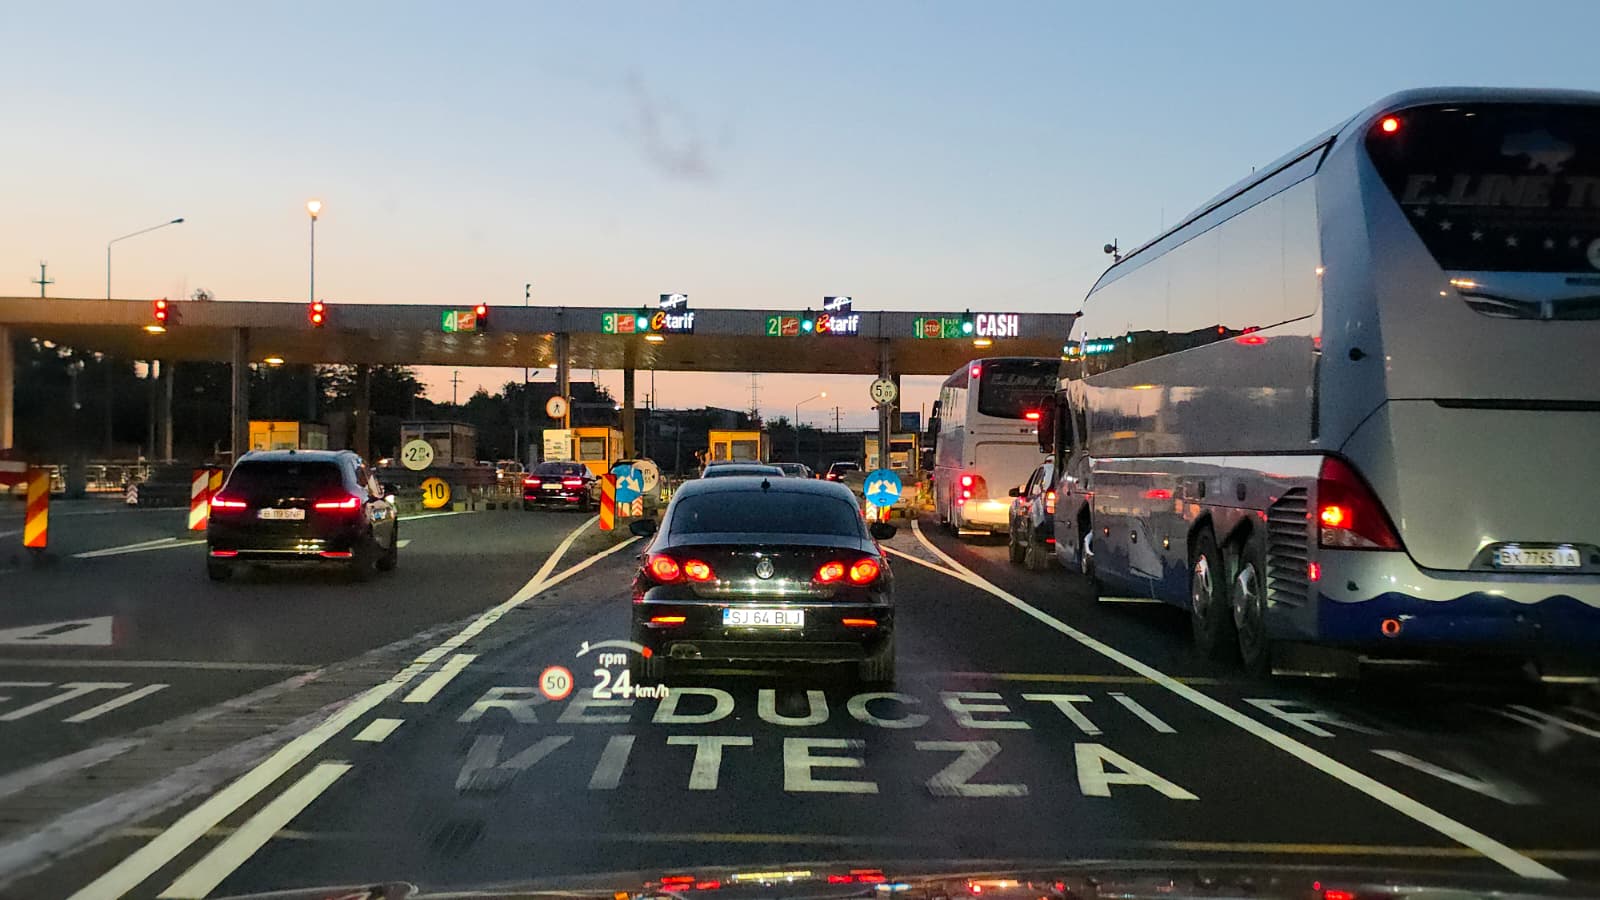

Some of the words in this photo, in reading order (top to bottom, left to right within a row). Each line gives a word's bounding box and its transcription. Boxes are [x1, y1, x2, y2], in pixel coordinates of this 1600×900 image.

[444, 312, 454, 331] 4
[604, 316, 614, 332] 3
[768, 318, 778, 335] 2
[914, 320, 920, 337] 1
[976, 314, 1019, 337] CASH
[875, 385, 882, 397] 5
[409, 447, 417, 461] 2
[428, 483, 445, 500] 10
[731, 611, 749, 624] SJ
[753, 611, 769, 624] 64
[775, 611, 800, 625] BLJ
[599, 653, 627, 667] rpm
[547, 676, 566, 690] 50
[592, 668, 633, 698] 24
[635, 684, 669, 698] km/h
[454, 735, 1201, 801] VITEZA
